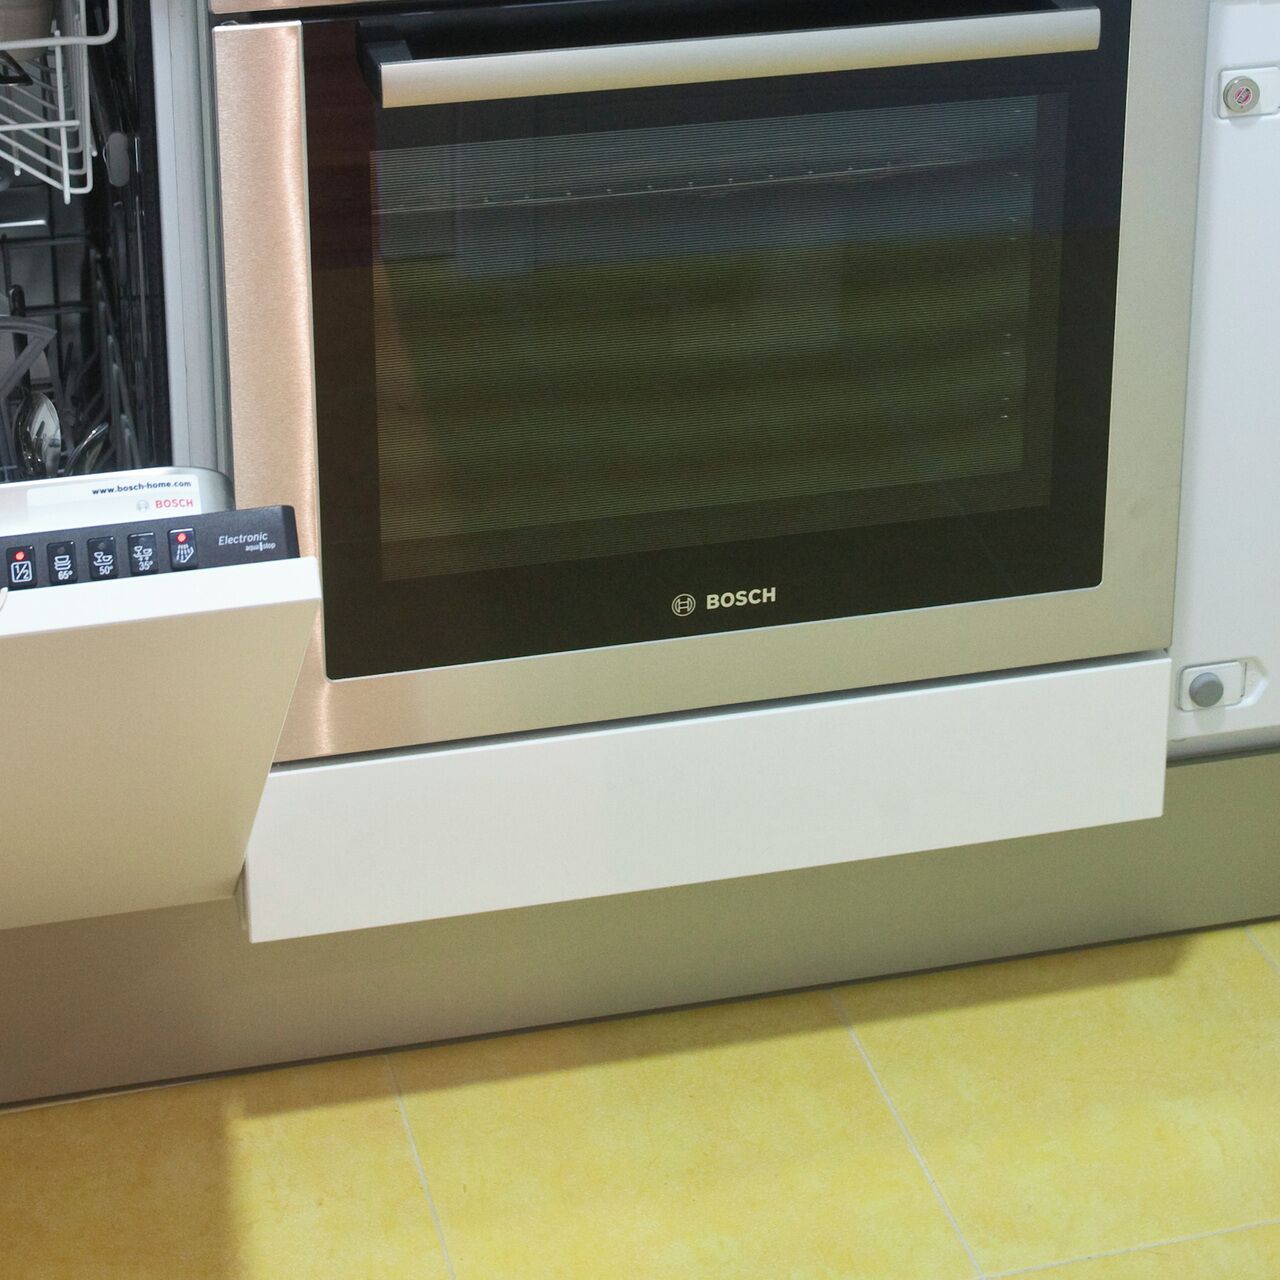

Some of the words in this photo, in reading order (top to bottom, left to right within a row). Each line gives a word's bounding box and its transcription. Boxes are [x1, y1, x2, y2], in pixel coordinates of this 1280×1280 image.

[92, 481, 192, 495] www.bosch-home.com
[155, 499, 194, 509] BOSCH
[218, 532, 268, 546] Electronic
[99, 565, 113, 575] 50°
[138, 560, 153, 571] 35°
[706, 587, 776, 610] BOSCH
